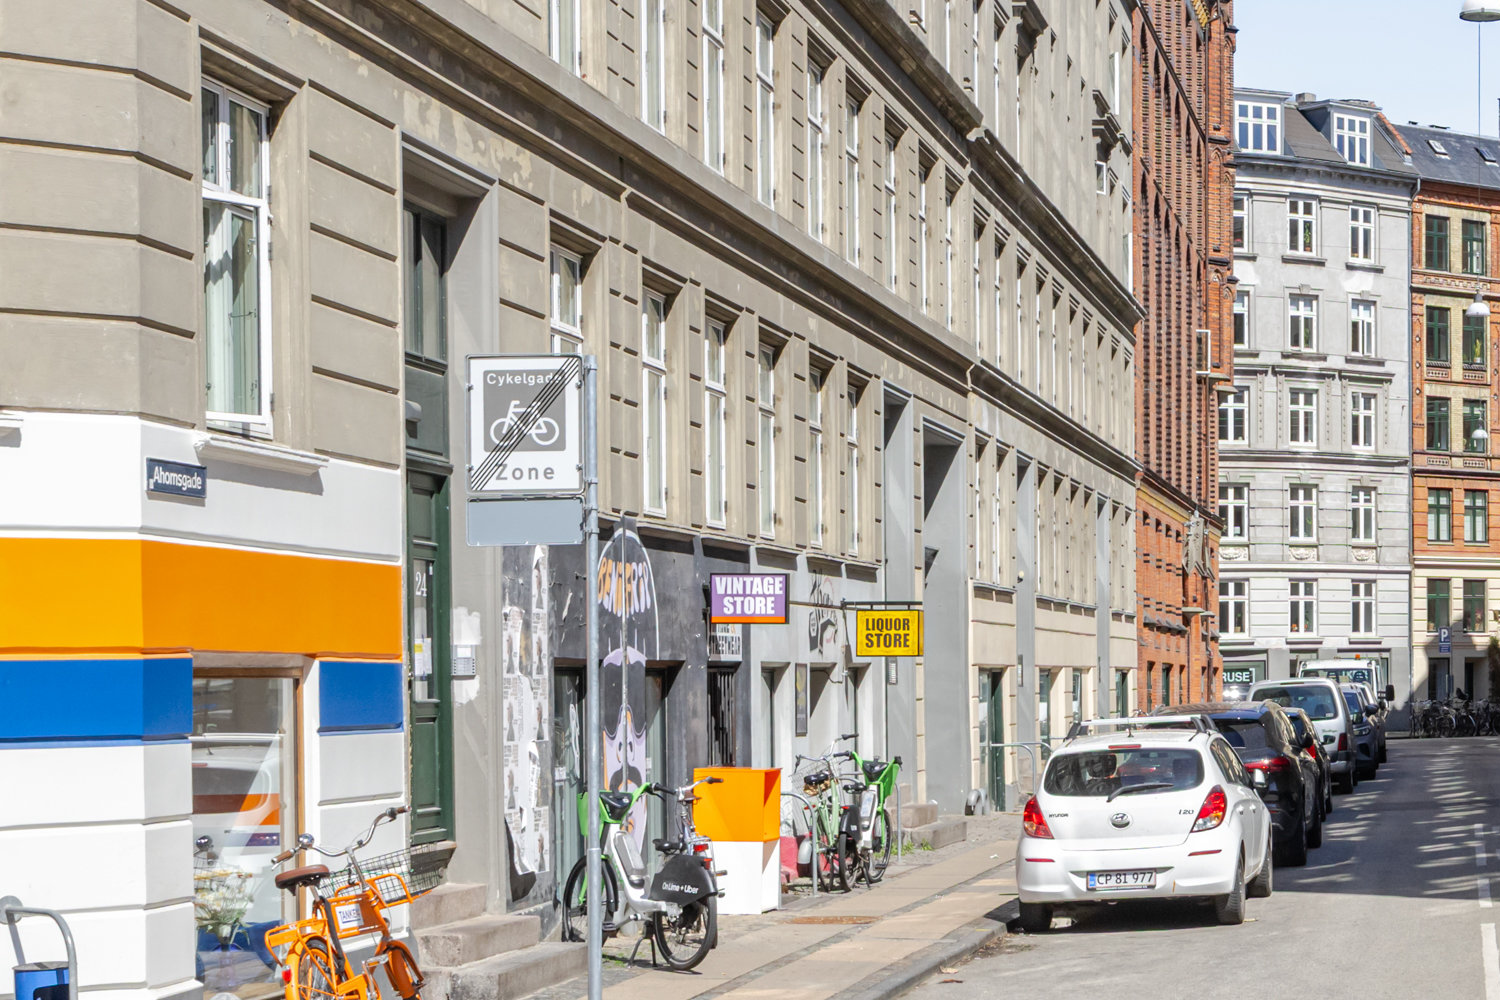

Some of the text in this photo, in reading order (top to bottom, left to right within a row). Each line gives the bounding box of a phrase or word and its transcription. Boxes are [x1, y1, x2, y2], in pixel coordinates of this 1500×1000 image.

[495, 463, 555, 480] Zone
[415, 571, 427, 597] 24
[715, 576, 783, 595] VINTAGE
[723, 596, 775, 615] STORE
[866, 618, 910, 631] LIQUOR
[865, 633, 910, 648] STORE
[1441, 629, 1449, 642] P
[1097, 871, 1154, 885] CP 81 977
[684, 885, 699, 894] Uber
